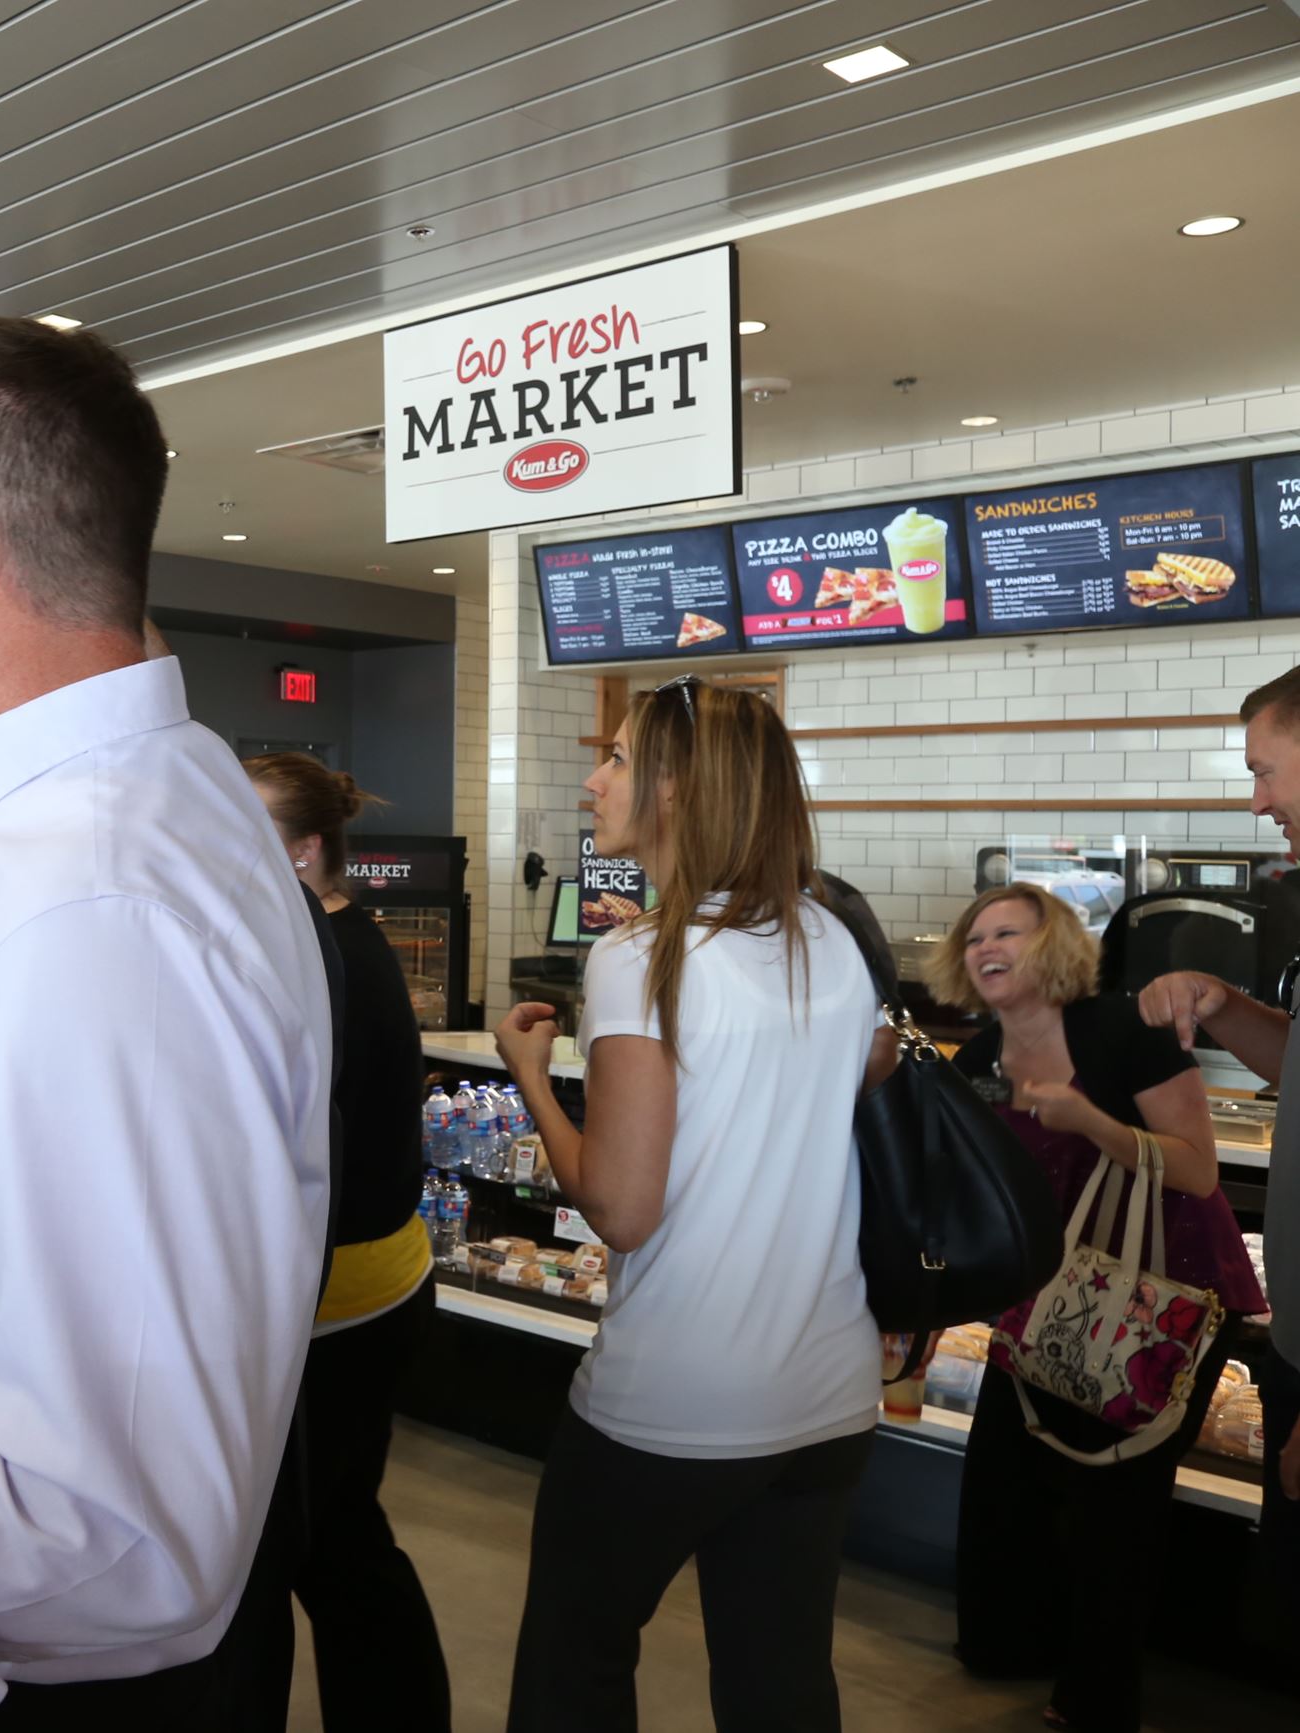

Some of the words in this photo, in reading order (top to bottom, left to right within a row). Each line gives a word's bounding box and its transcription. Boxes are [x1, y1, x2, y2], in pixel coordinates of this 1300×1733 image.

[522, 304, 640, 370] Fresh
[402, 342, 708, 461] MARKET
[975, 492, 1098, 522] SANDWICHES
[1120, 512, 1162, 525] KITCHEN
[1164, 508, 1194, 520] HOURS
[1048, 518, 1102, 533] SANDWICHES
[745, 536, 808, 558] PIZZA
[812, 528, 878, 551] COMBO
[286, 672, 311, 702] EXIT
[345, 864, 411, 877] MARKET
[584, 869, 640, 892] HERE
